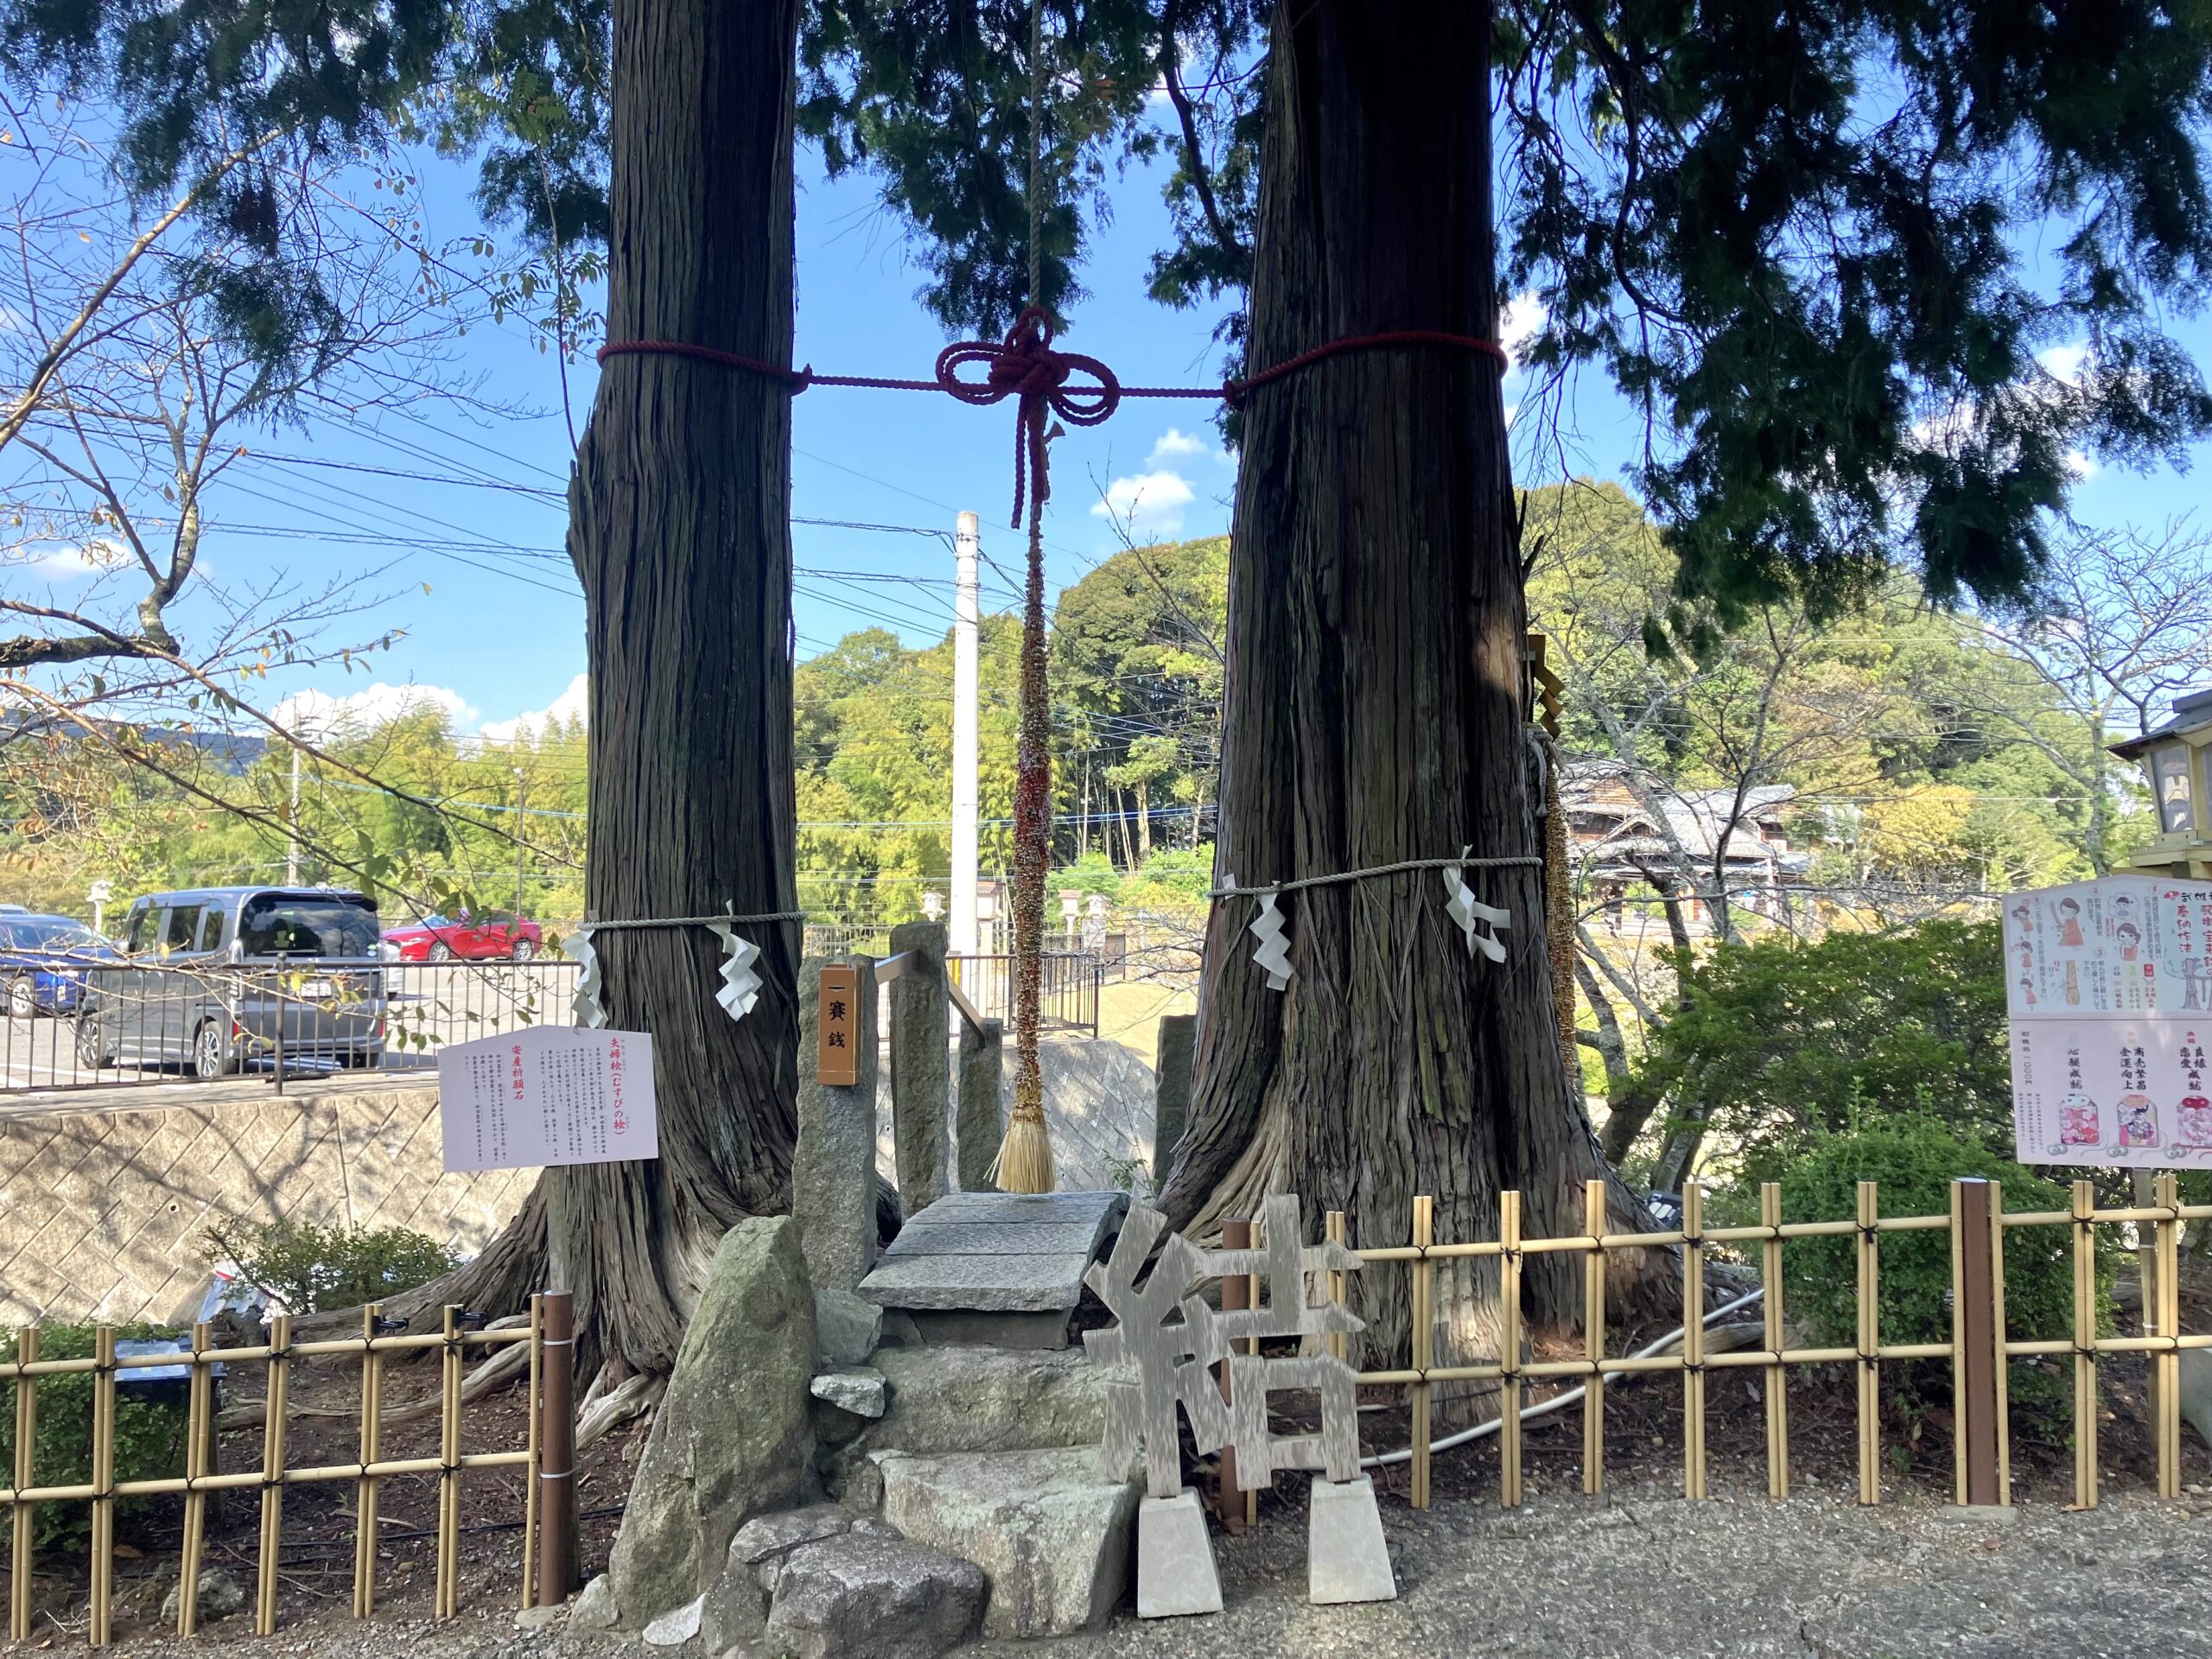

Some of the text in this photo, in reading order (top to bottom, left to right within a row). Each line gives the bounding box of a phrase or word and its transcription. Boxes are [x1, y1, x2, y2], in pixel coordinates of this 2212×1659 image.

[2177, 904, 2191, 952] 奉納作法
[828, 1001, 846, 1048] 賽銭
[512, 1045, 524, 1100] 安産祈願石
[2068, 1048, 2082, 1090] 心願成就
[2120, 1046, 2134, 1090] 金運向上
[2134, 1046, 2147, 1090] 商売繁昌
[2180, 1046, 2192, 1069] 恋愛
[2188, 1069, 2202, 1090] 成就
[2194, 1046, 2207, 1069] 良縁
[1083, 1194, 1365, 1497] 結
